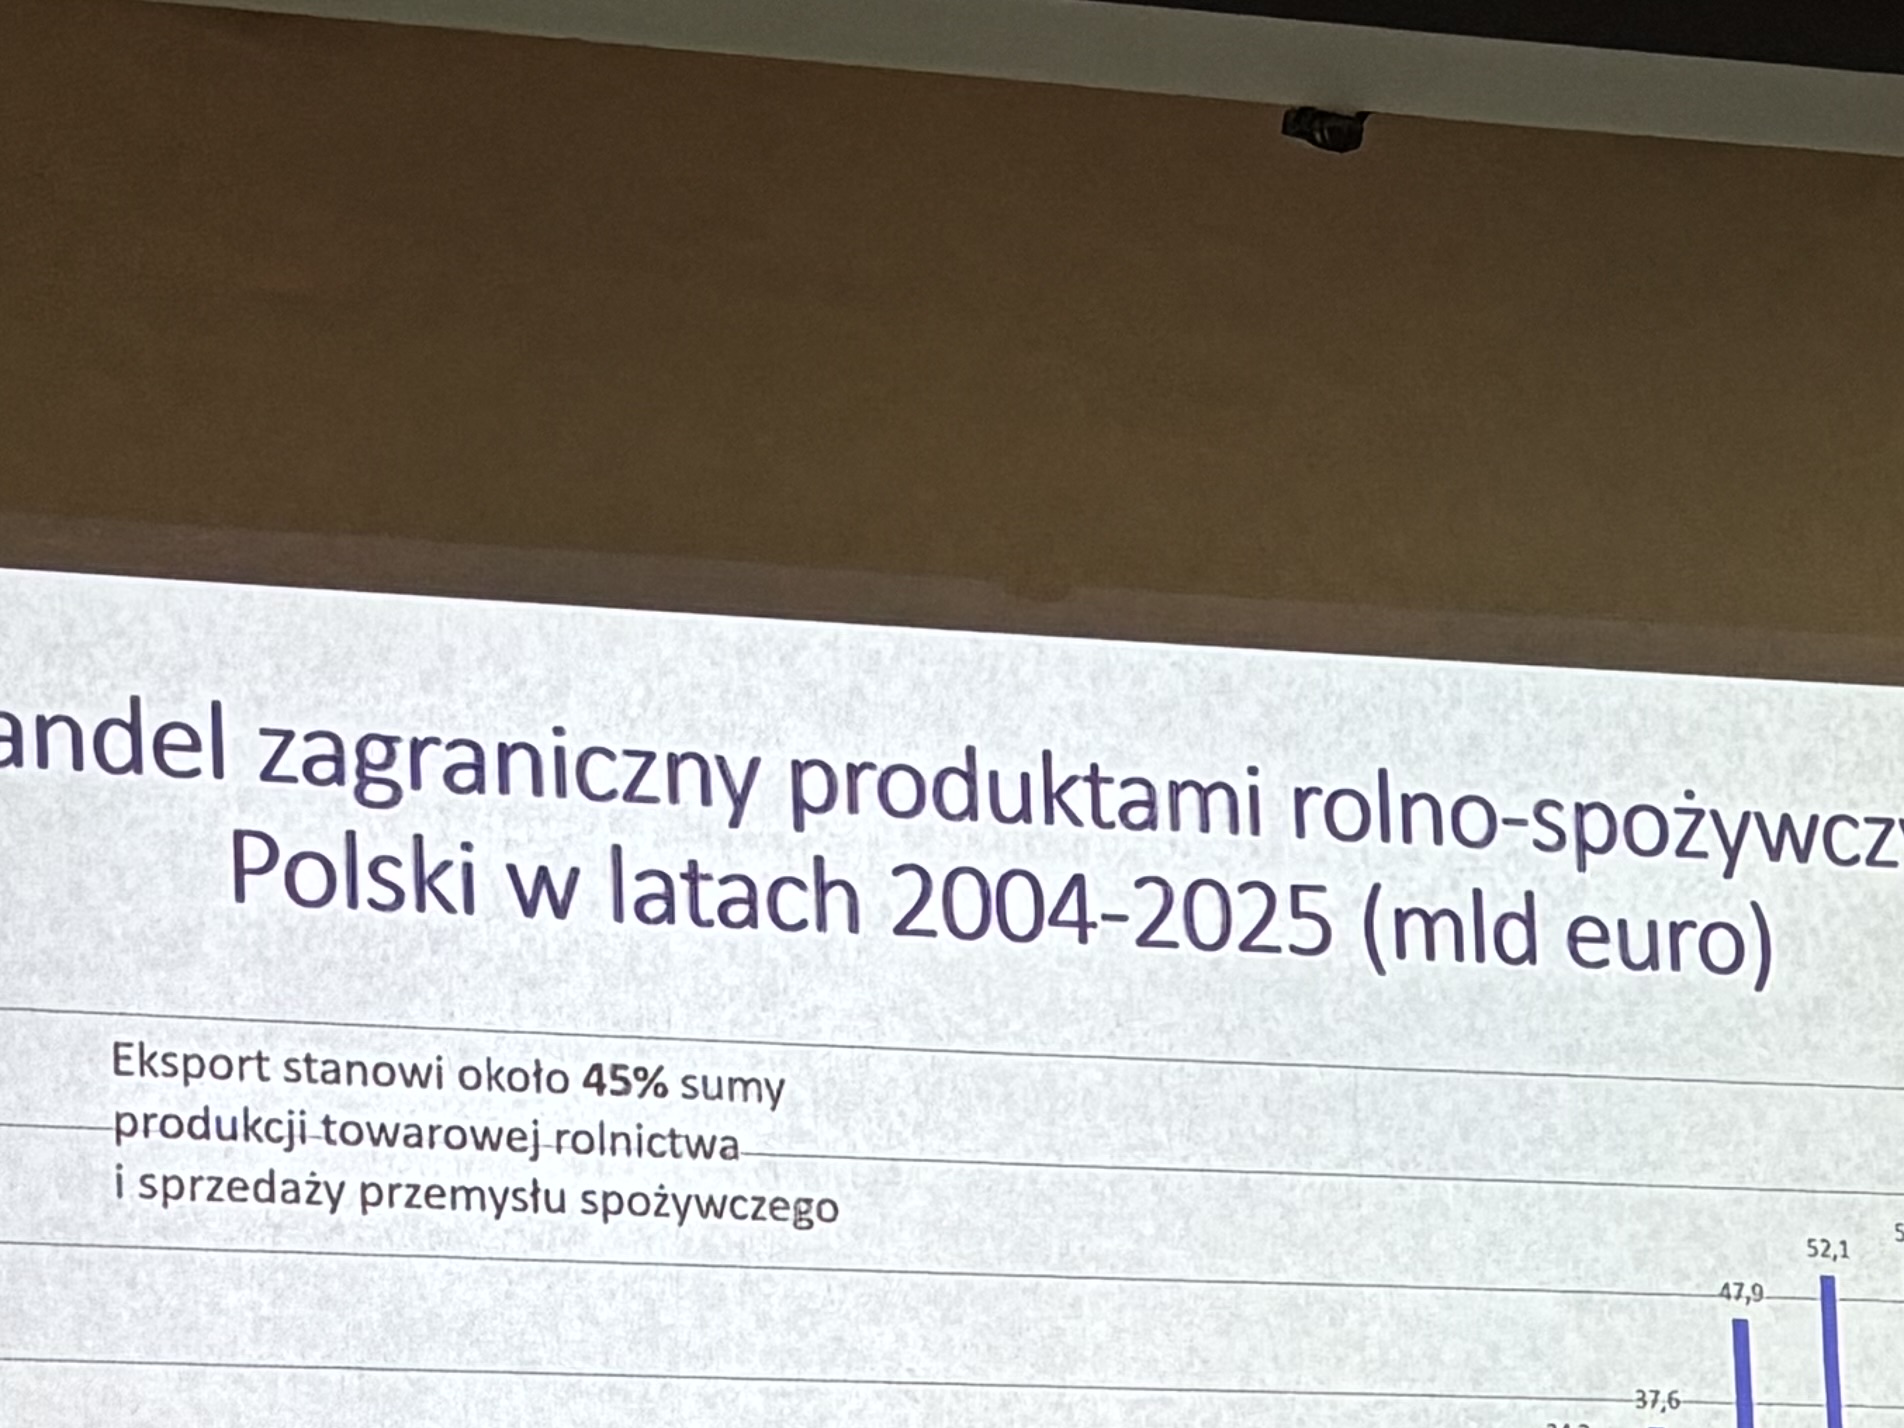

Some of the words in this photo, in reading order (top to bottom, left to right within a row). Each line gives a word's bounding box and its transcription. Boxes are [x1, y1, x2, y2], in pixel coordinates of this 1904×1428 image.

[258, 725, 761, 829] zagraniczny
[792, 744, 1261, 832] produktami
[232, 827, 475, 917] Polski
[506, 864, 580, 920] w
[611, 844, 859, 935] latach
[892, 862, 1333, 956] 2004-2025
[1362, 882, 1537, 977] (mld
[1567, 898, 1774, 992] euro)
[112, 1042, 271, 1088] Eksport
[283, 1051, 444, 1092] stanowi
[457, 1055, 570, 1096] około
[582, 1063, 669, 1100] 45%
[680, 1072, 785, 1111] sumy
[114, 1104, 311, 1154] produkcji
[321, 1113, 540, 1162] towarowej
[554, 1118, 741, 1162] rolnictwa
[114, 1164, 124, 1200] i
[139, 1164, 345, 1215] sprzedaży
[358, 1175, 567, 1220] przemysłu
[580, 1177, 840, 1230] spożywczego
[1806, 1239, 1851, 1262] 52,1
[1720, 1282, 1764, 1305] 47,9
[1635, 1390, 1680, 1413] 37,6
